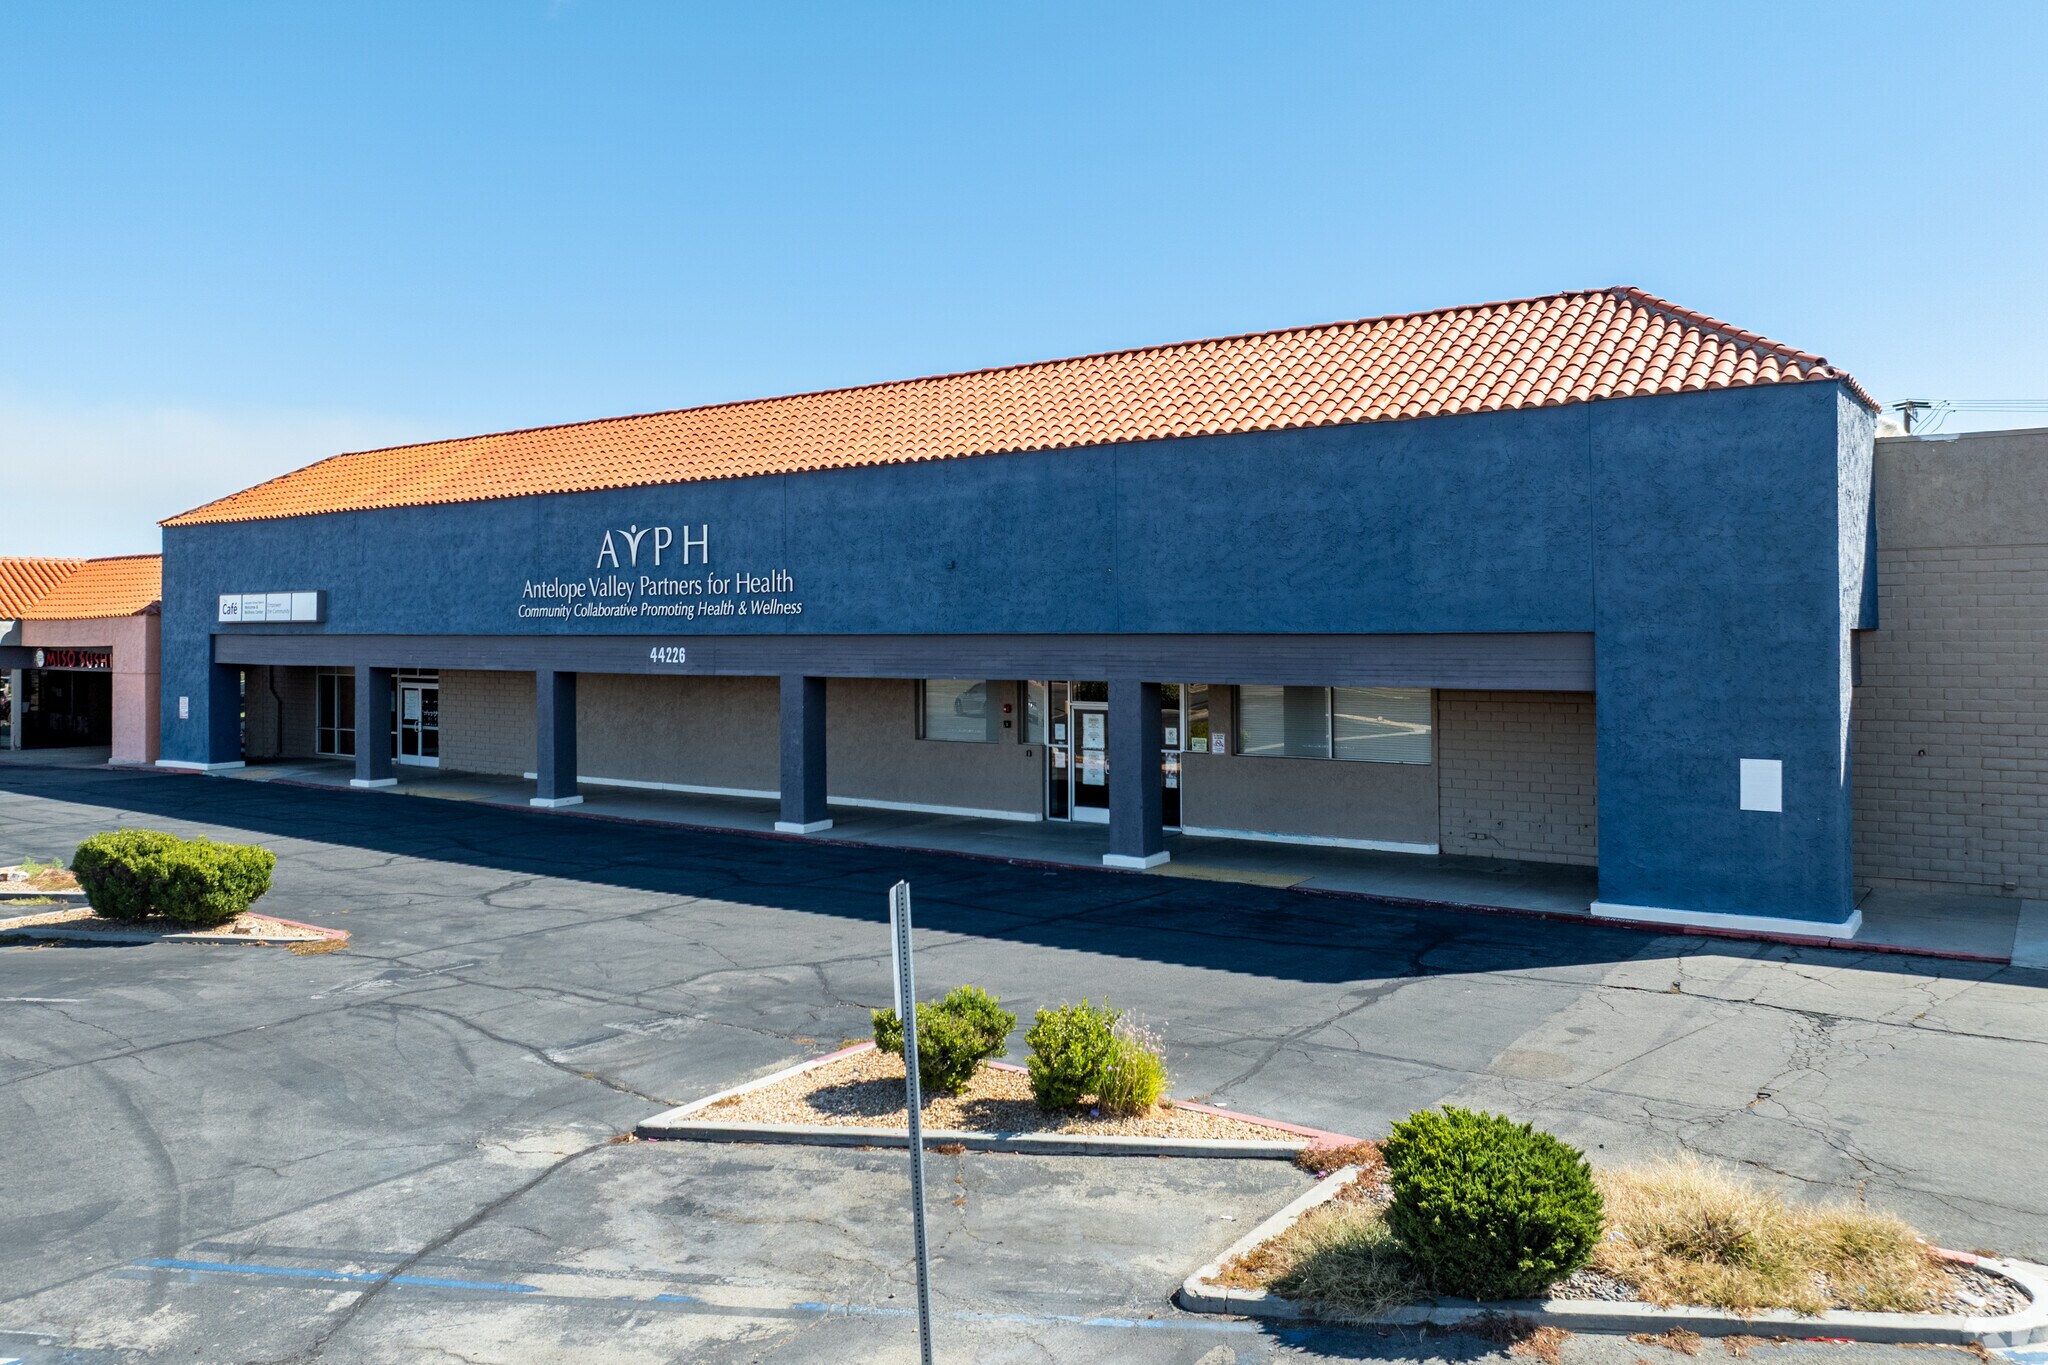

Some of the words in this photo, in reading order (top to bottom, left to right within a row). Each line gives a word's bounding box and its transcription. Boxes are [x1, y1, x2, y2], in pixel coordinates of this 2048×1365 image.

[522, 577, 586, 603] Antelope
[588, 575, 635, 602] Valley
[640, 575, 702, 595] Partners
[707, 571, 730, 594] for
[736, 569, 793, 593] Health
[222, 602, 238, 615] Café
[518, 604, 572, 621] Community
[574, 602, 638, 616] Collaborative
[640, 602, 695, 620] Promoting
[697, 600, 734, 616] Health
[738, 600, 748, 615] &
[750, 598, 803, 615] Wellness
[46, 650, 75, 667] MISO
[80, 651, 112, 668] SUSHI
[650, 647, 686, 664] 44226
